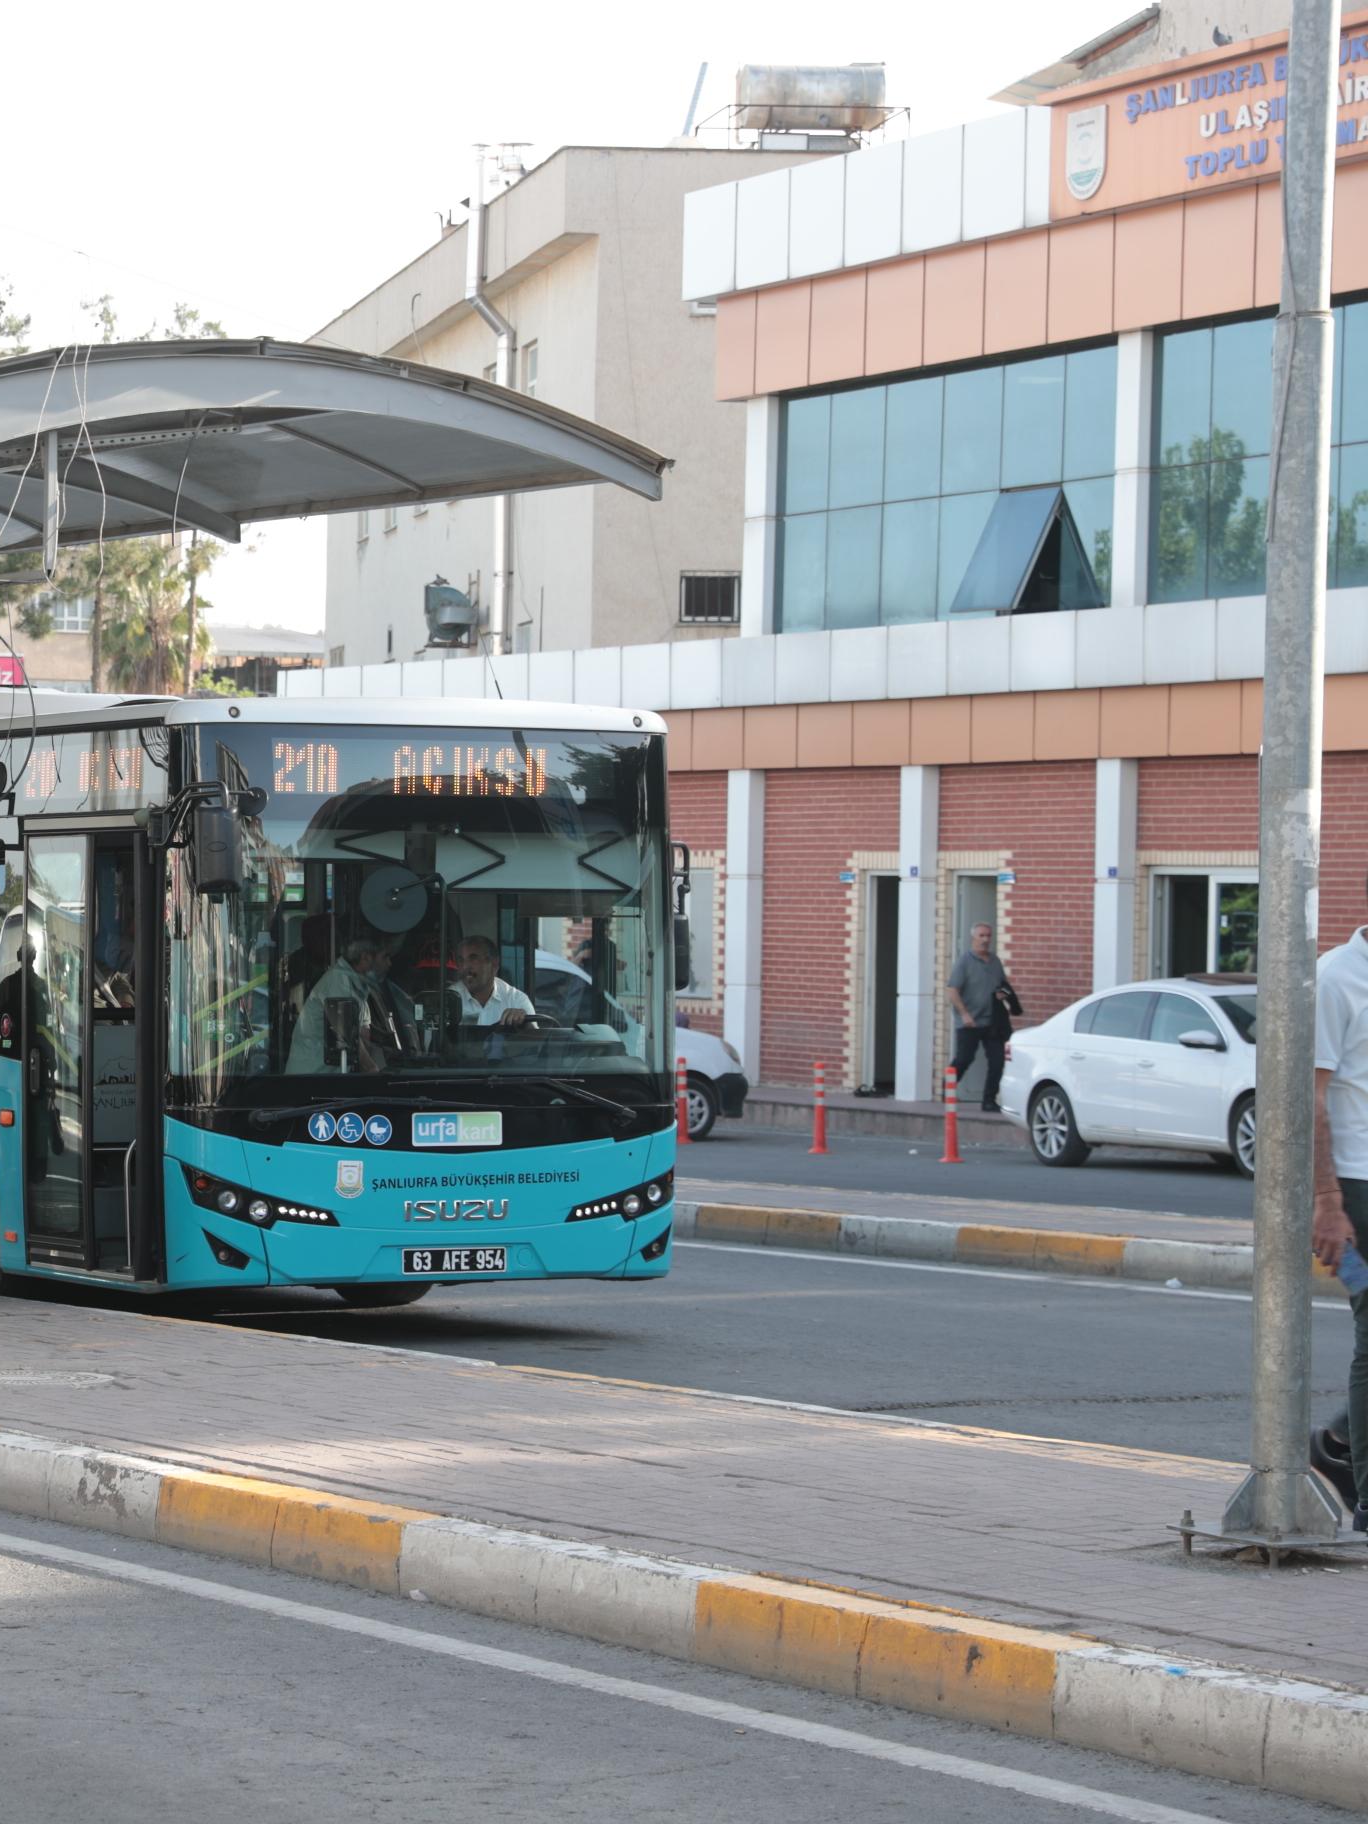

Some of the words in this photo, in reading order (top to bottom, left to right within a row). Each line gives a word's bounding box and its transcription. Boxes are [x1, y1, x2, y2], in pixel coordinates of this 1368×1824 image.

[1126, 62, 1267, 124] ŞANLIURFA
[1184, 139, 1268, 180] TOPLU
[371, 1176, 438, 1192] ŞANLIURFA
[441, 1171, 515, 1188] BÜYÜKŞEHİR
[518, 1171, 580, 1185] BELEDİYESİ
[404, 1199, 509, 1222] ISUZU
[412, 1251, 432, 1271] 63
[442, 1250, 471, 1271] AFE
[475, 1249, 504, 1270] 954
